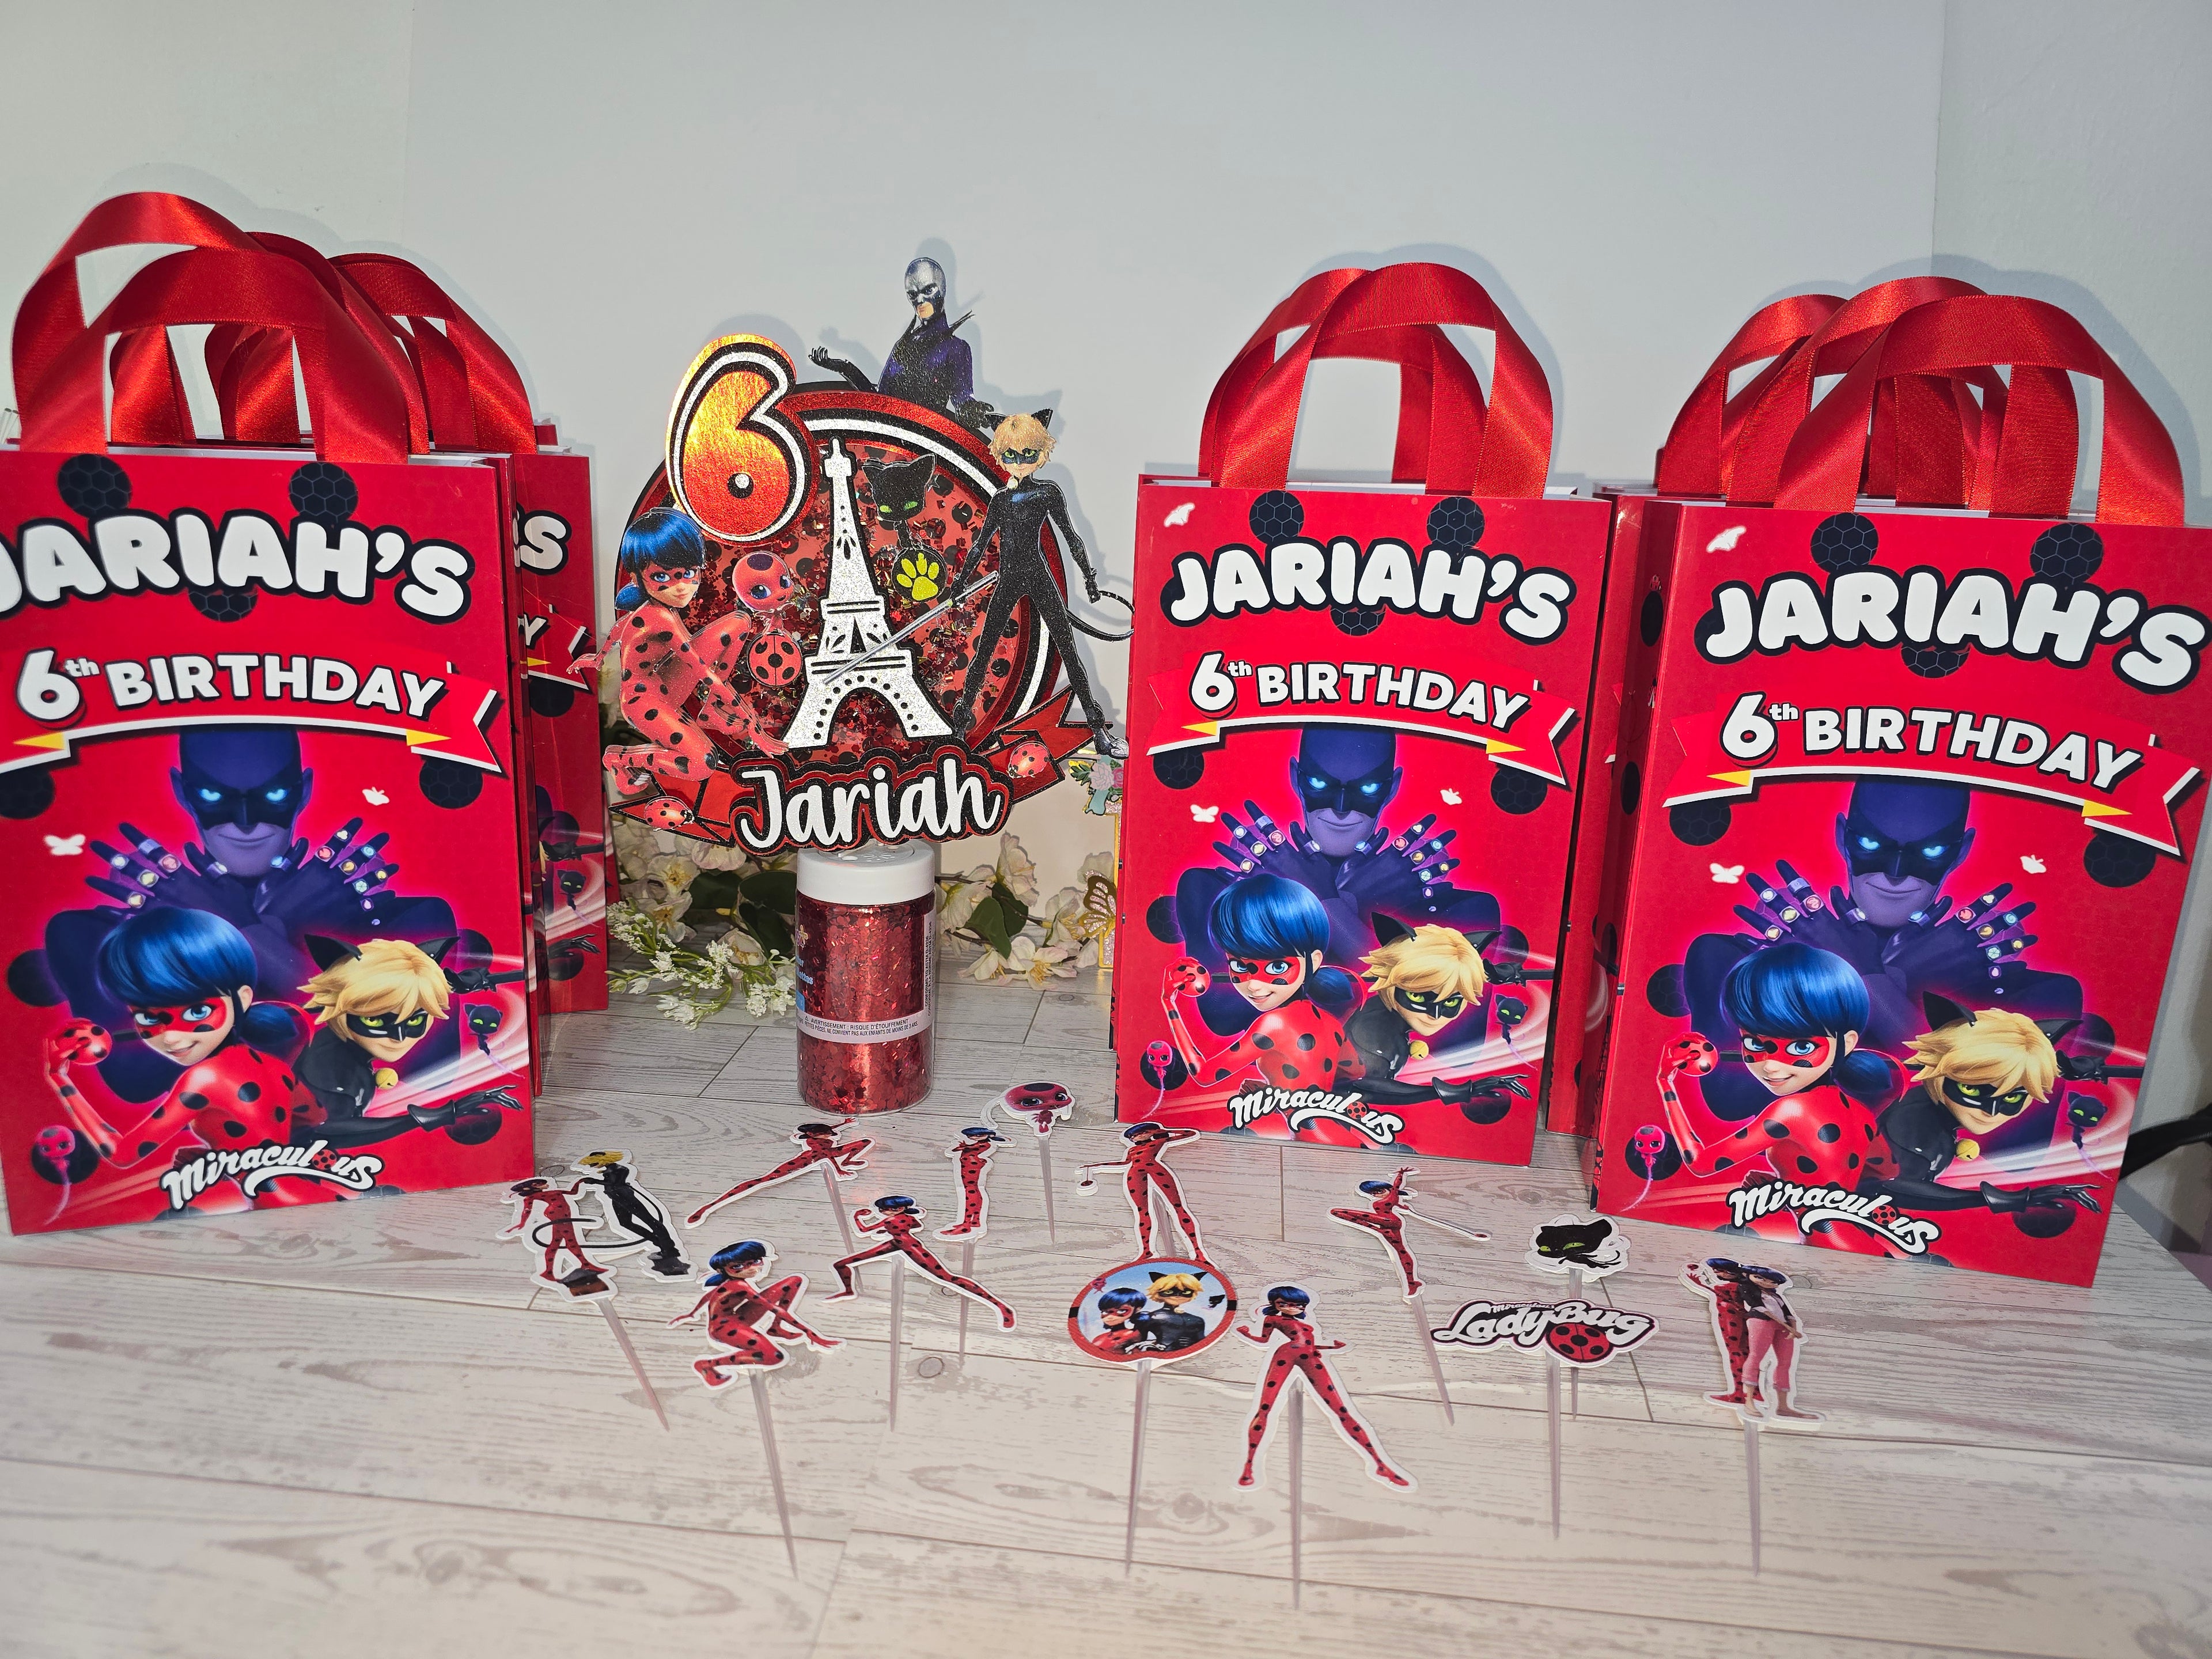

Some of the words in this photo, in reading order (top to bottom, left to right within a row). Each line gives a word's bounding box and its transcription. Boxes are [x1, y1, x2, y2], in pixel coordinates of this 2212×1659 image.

[668, 336, 809, 543] 6
[1170, 541, 1570, 639] JARIAH'S
[1705, 571, 2206, 687] JARIAH'S
[18, 649, 100, 720] 6th
[105, 654, 445, 717] BIRTHDAY
[1191, 653, 1252, 711] 6th
[1257, 664, 1529, 729] BIRTHDAY
[1722, 694, 1799, 759] 6th
[1805, 708, 2142, 789] BIRTHDAY
[740, 758, 1002, 849] Jariah
[810, 1018, 846, 1029] AVERTISSEMENT
[870, 1018, 909, 1030] D'ÉTOUFFEMENT
[1229, 1086, 1404, 1144] Miraculous
[161, 1139, 383, 1210] Miraculous
[1728, 1180, 1940, 1255] Miraculous
